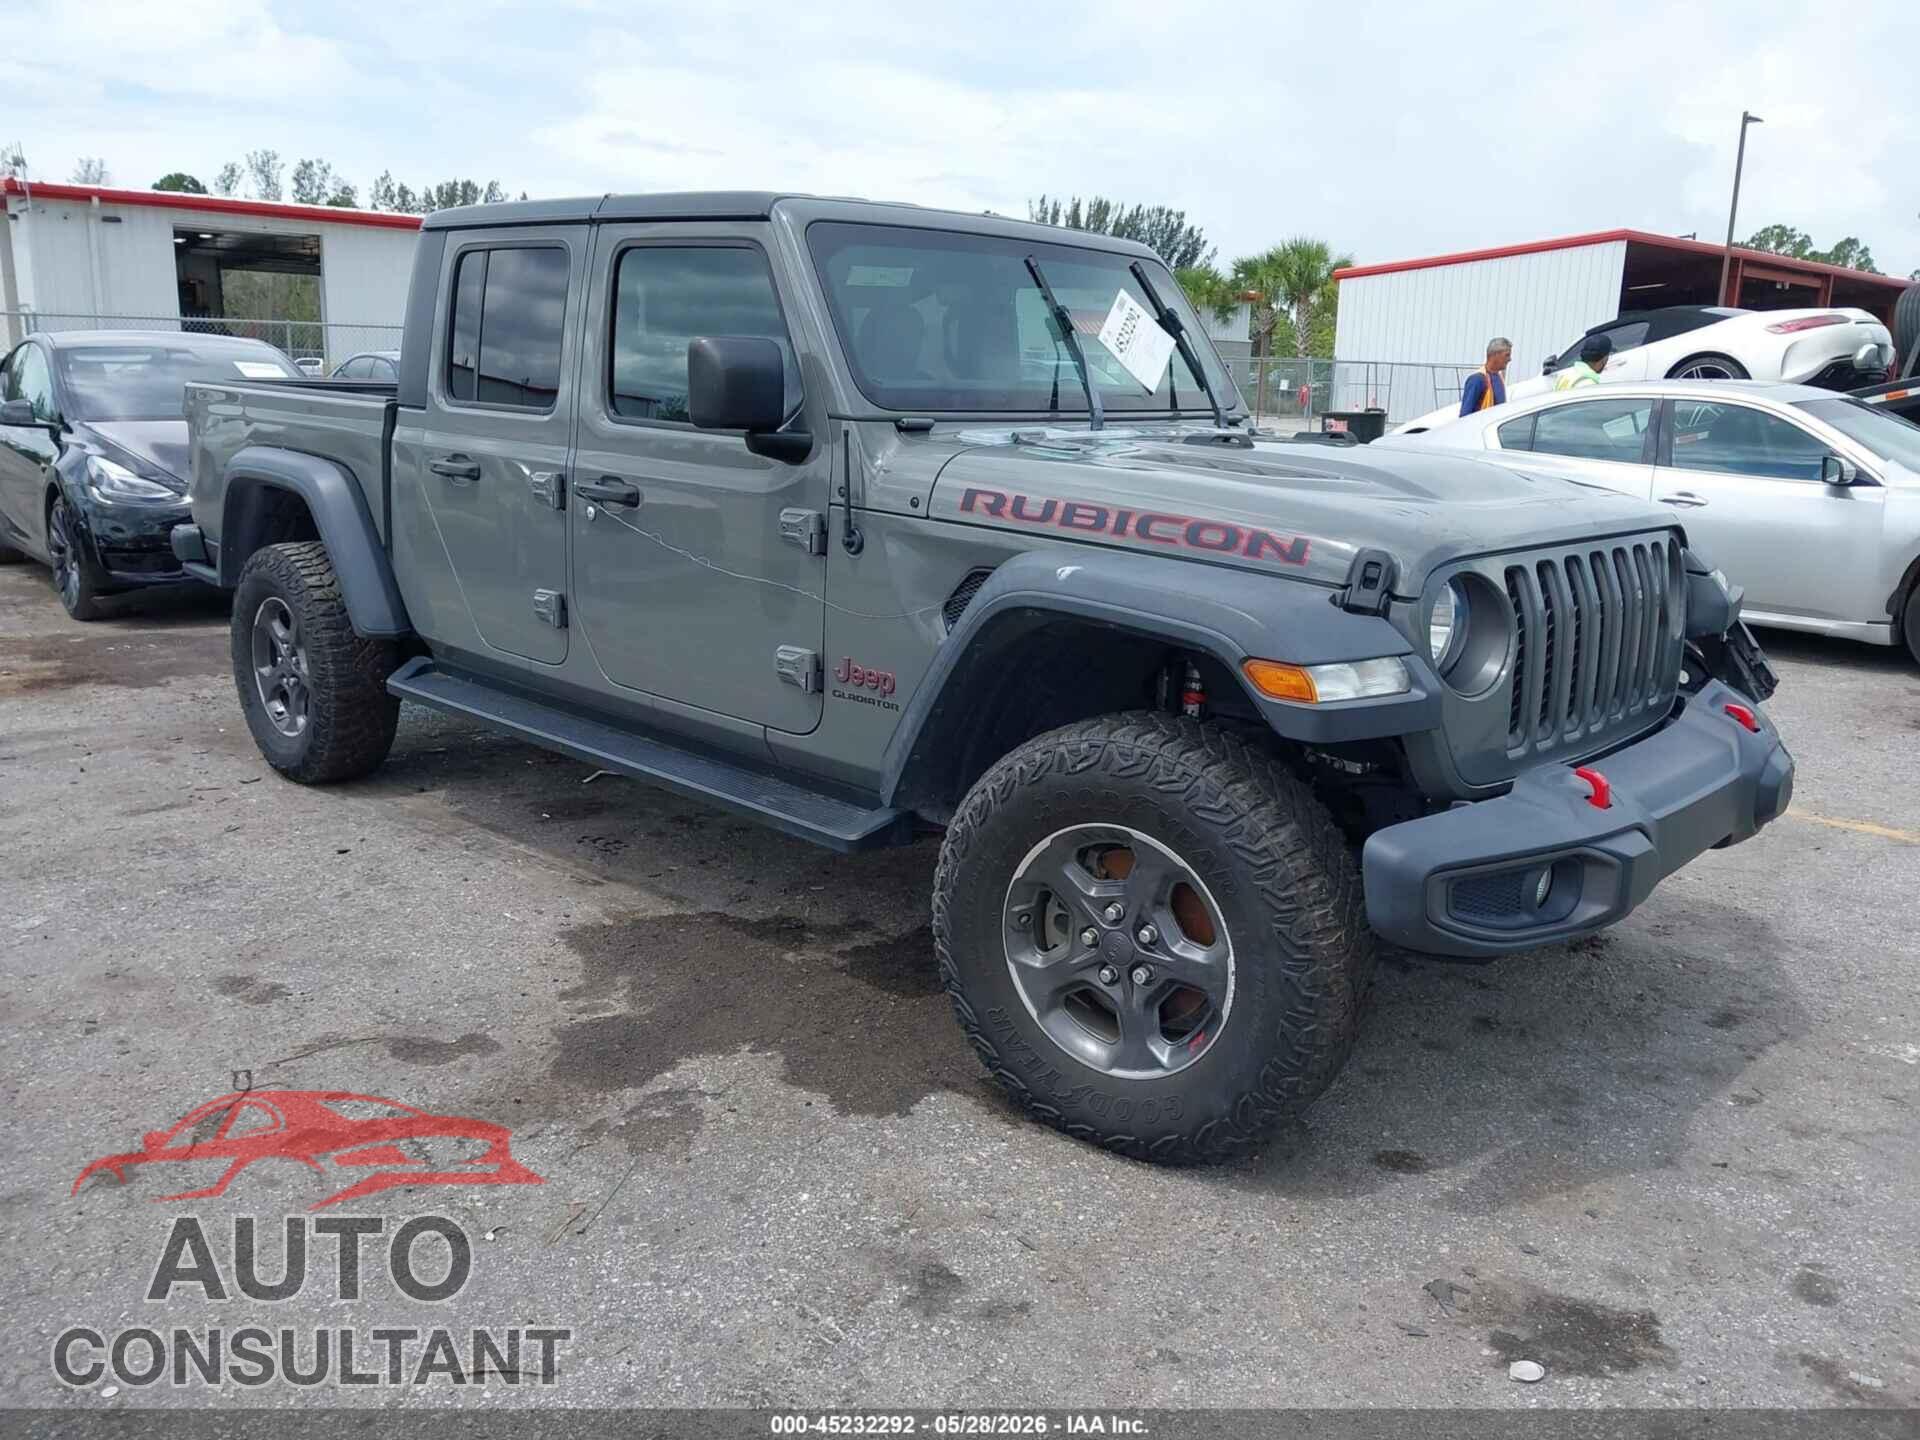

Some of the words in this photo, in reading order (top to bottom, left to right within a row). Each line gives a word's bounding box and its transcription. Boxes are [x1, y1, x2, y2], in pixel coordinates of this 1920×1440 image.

[959, 487, 1313, 566] RUBICON
[833, 656, 896, 699] Jeep
[832, 689, 900, 712] GLADIATOR
